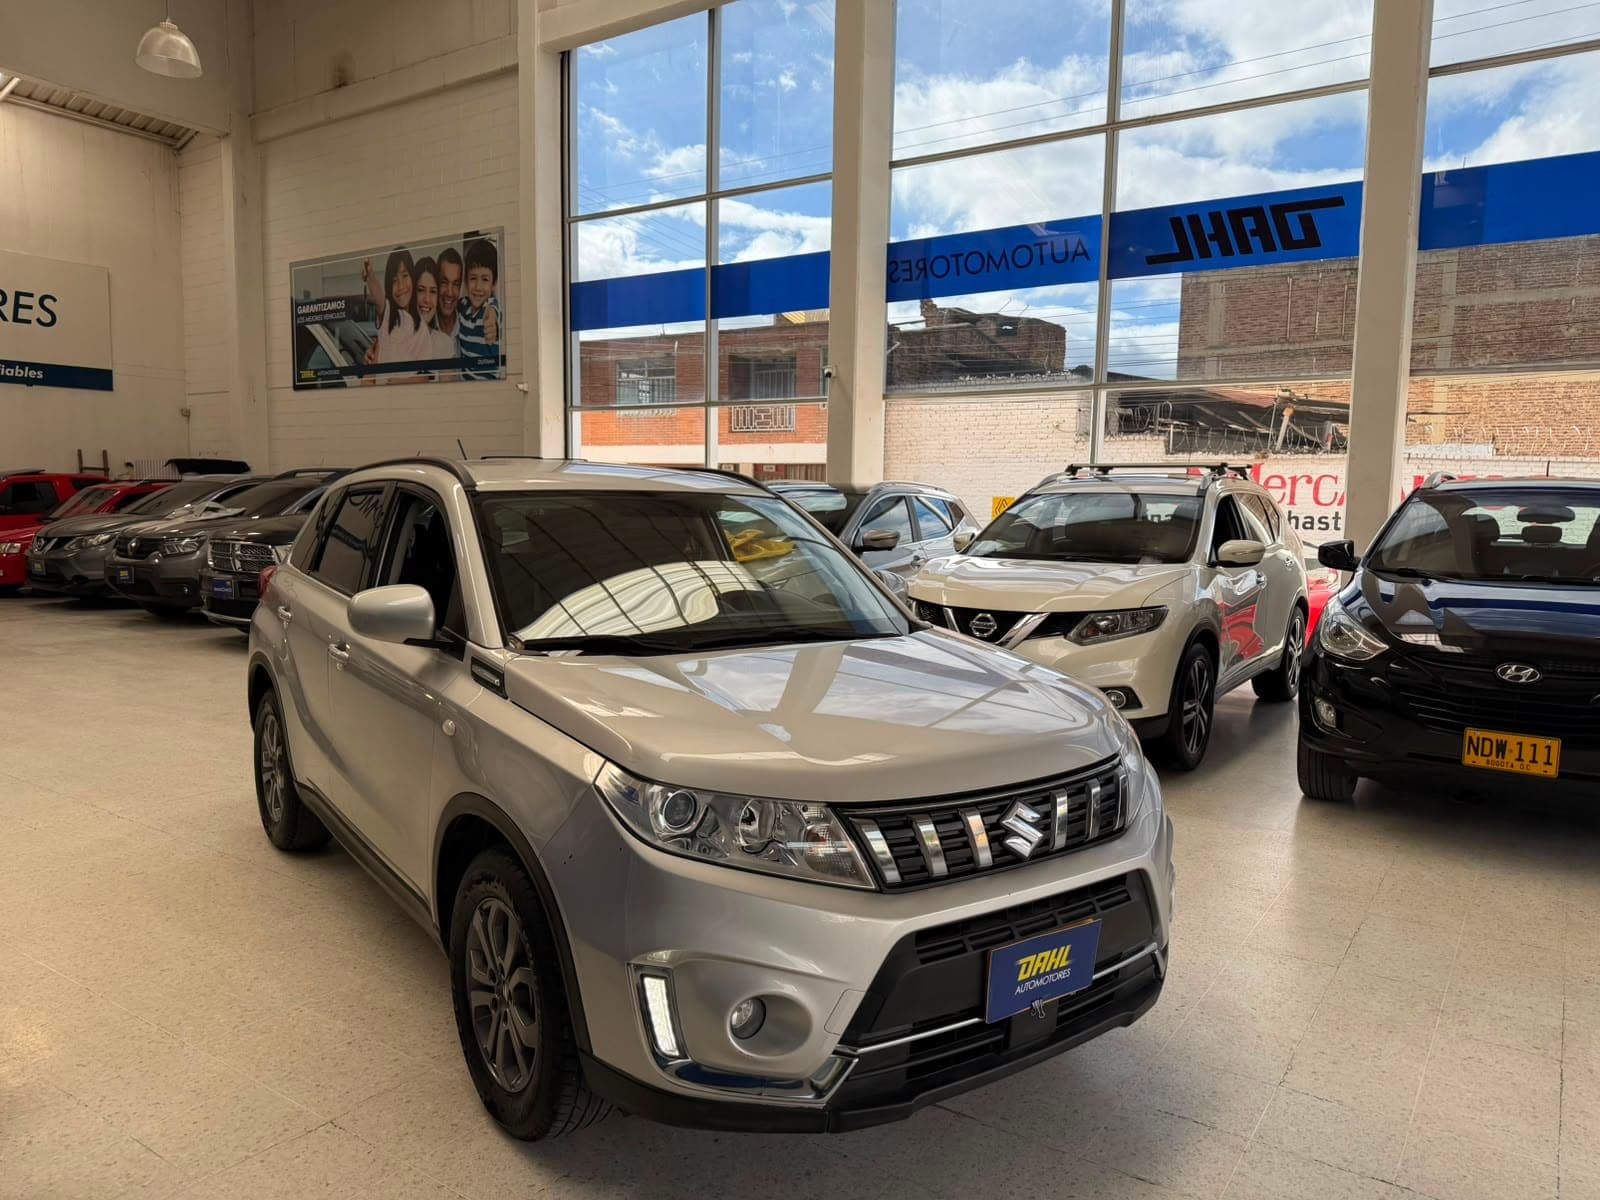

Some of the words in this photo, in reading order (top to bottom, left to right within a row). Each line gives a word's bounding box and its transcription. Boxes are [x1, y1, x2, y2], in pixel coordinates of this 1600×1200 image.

[297, 300, 346, 314] GARANTIZAMOS
[0, 364, 44, 379] iables
[1015, 944, 1073, 982] DAHL
[1014, 968, 1072, 996] AUTOMOTORES
